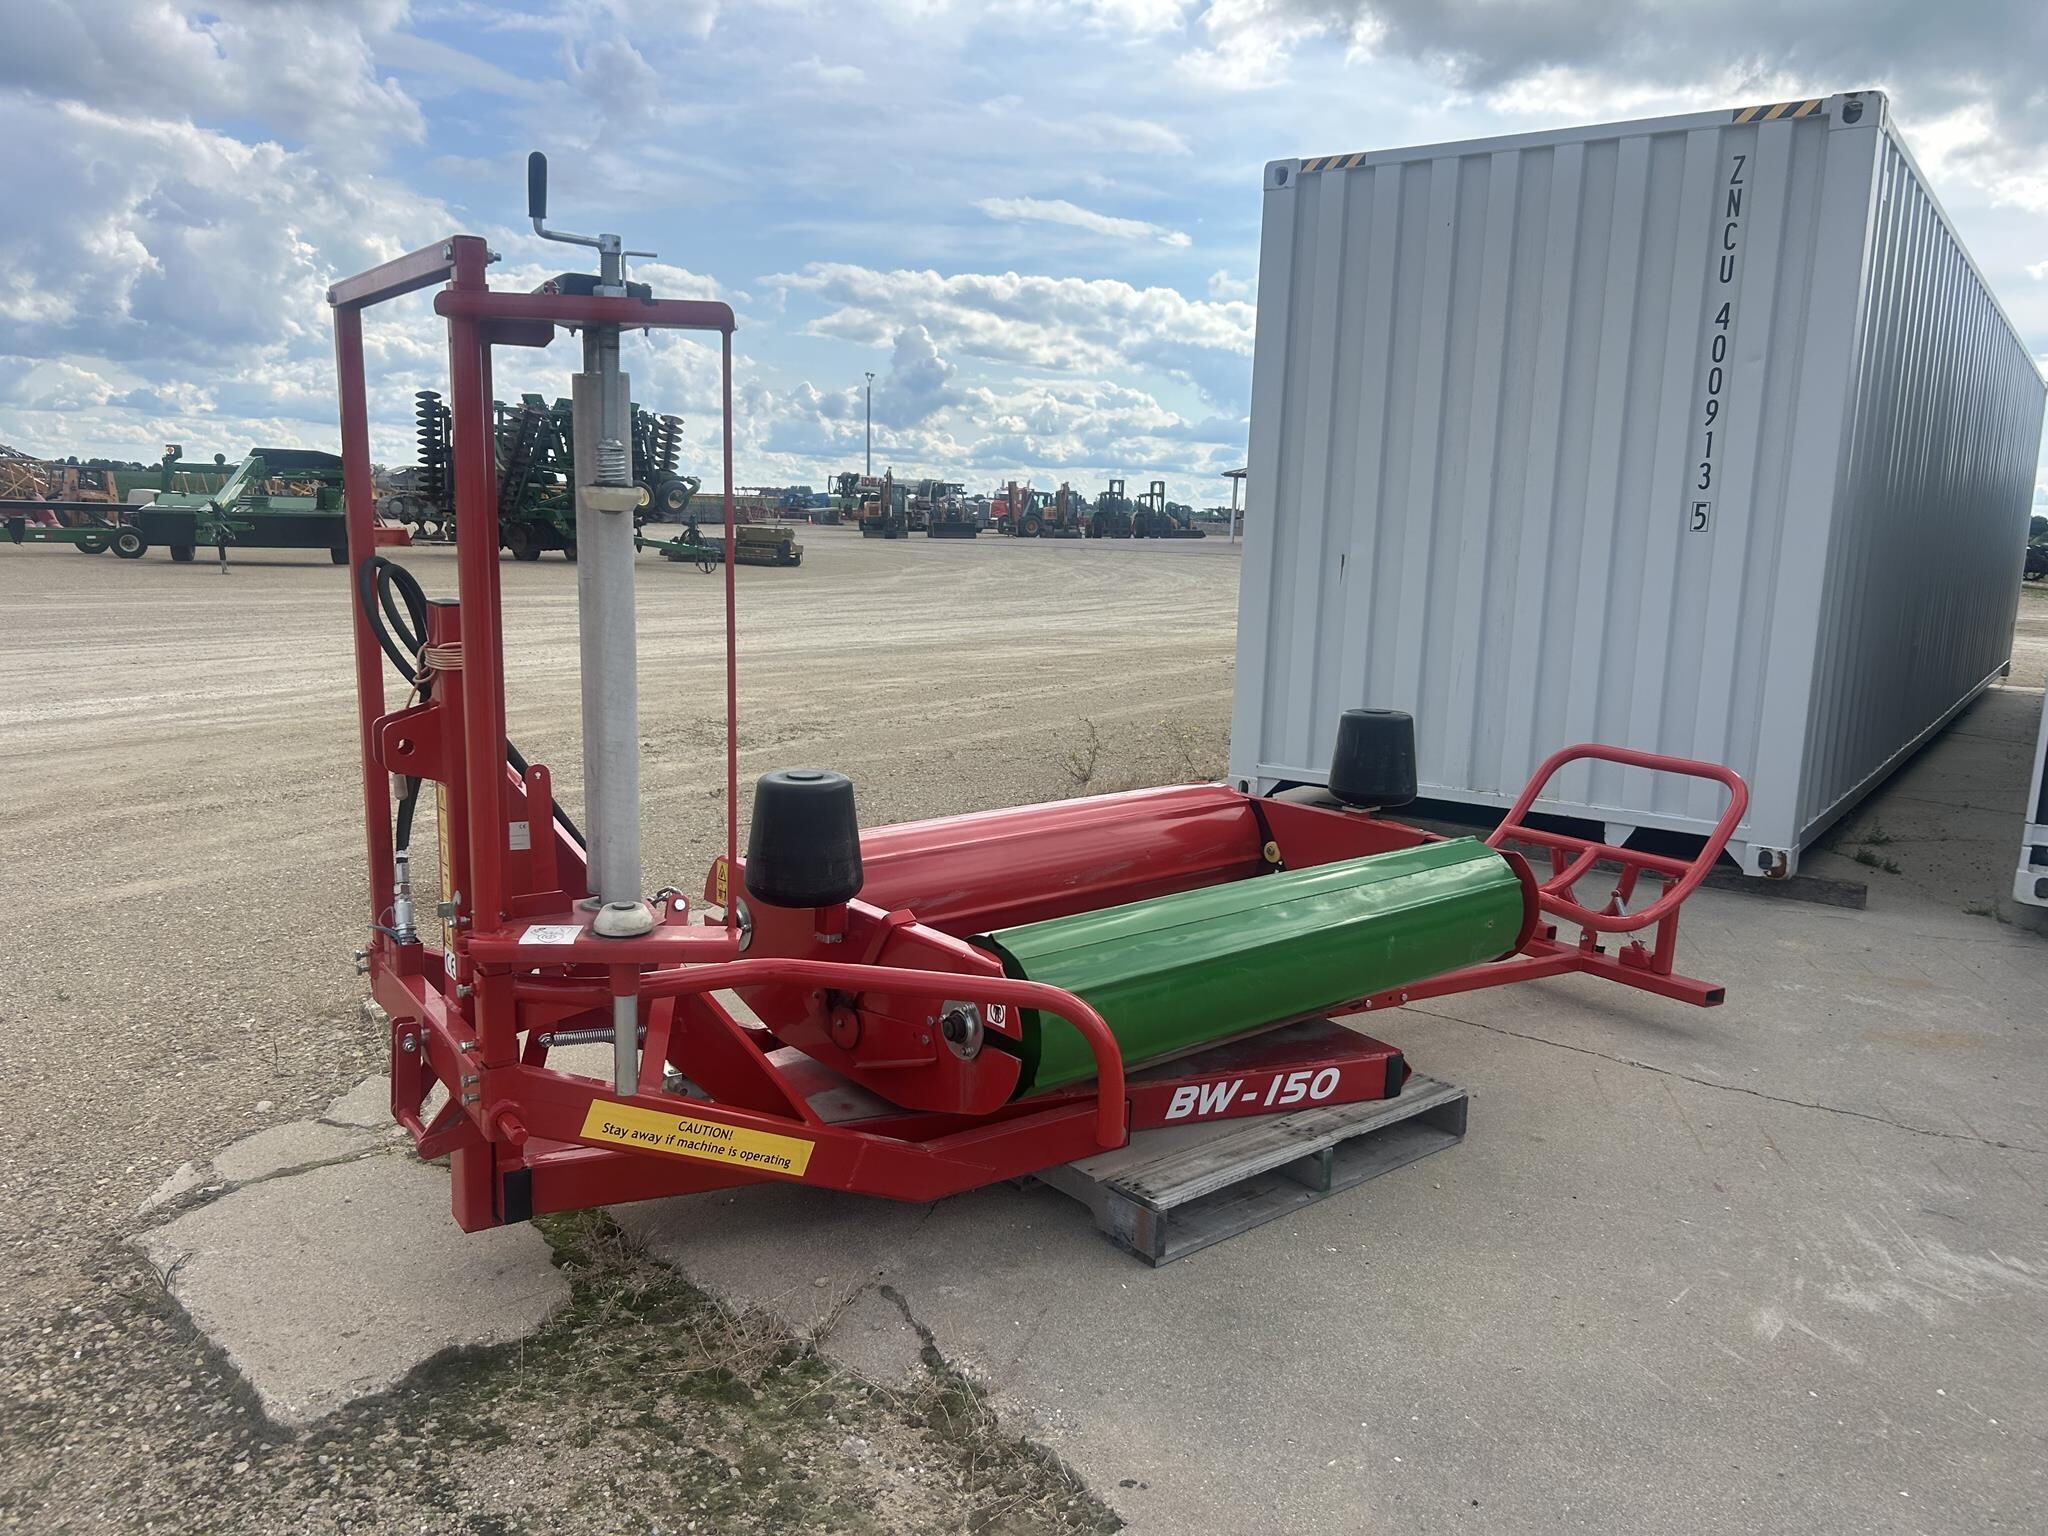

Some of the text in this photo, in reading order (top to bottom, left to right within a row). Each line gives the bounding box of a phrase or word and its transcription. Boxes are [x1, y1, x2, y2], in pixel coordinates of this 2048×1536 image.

[1692, 155, 1746, 530] ZNCU 400913 5
[602, 1122, 792, 1169] Stay away if machine is operating
[678, 1121, 733, 1140] CAUTION!
